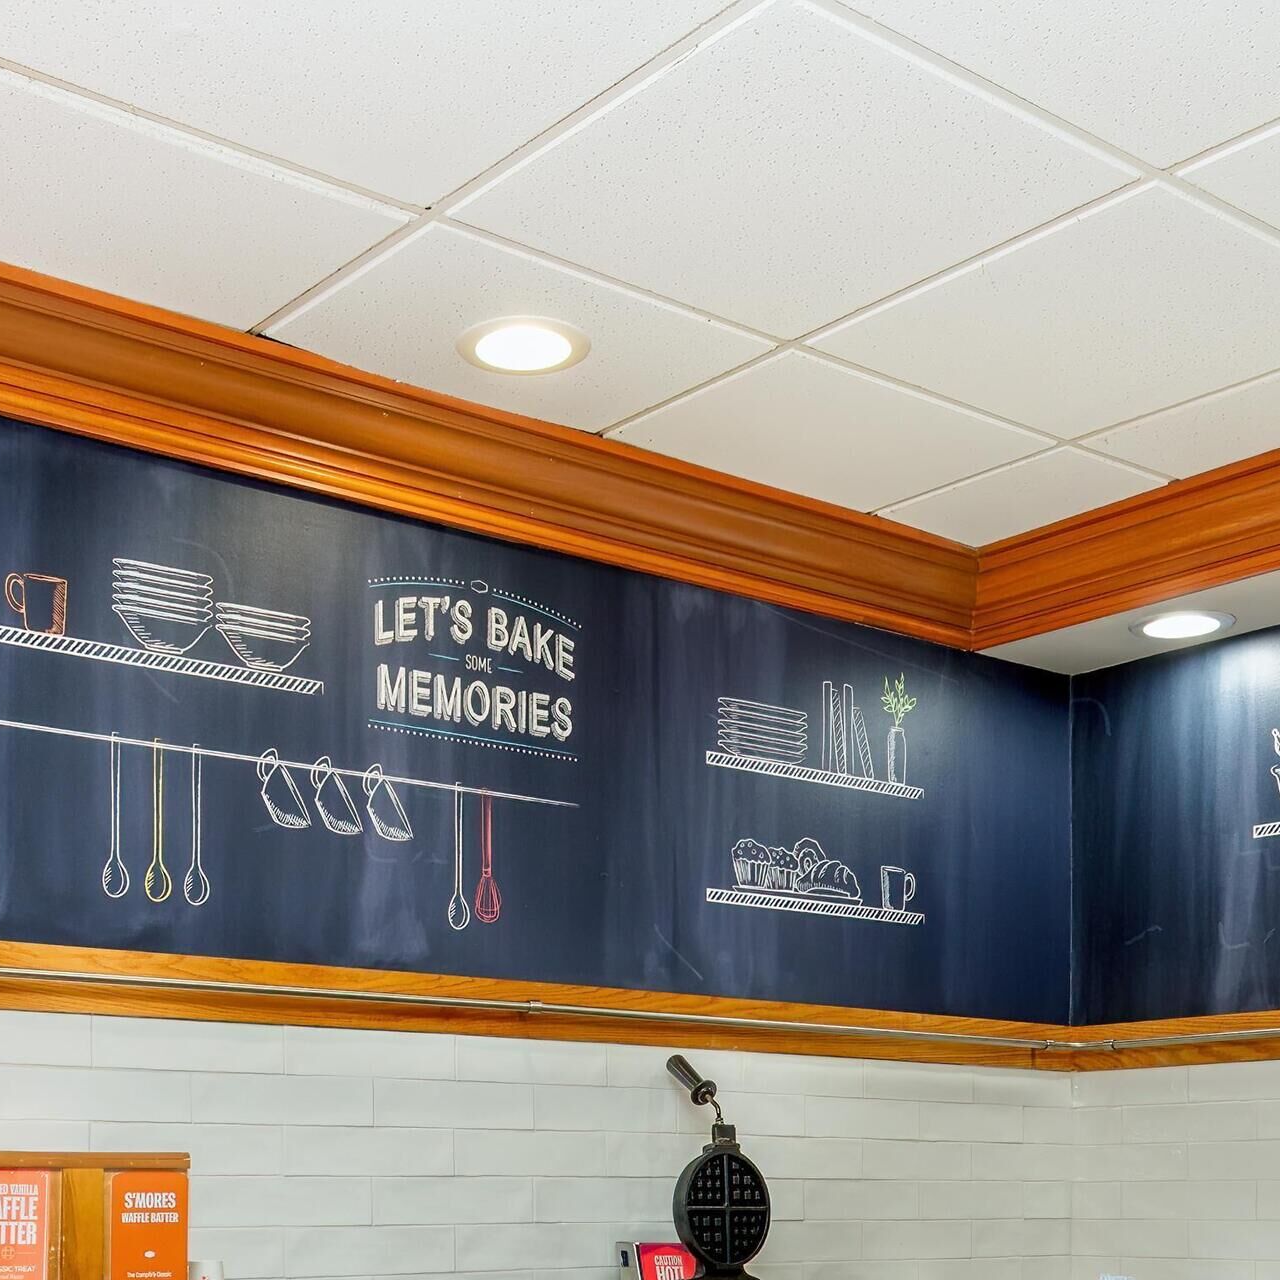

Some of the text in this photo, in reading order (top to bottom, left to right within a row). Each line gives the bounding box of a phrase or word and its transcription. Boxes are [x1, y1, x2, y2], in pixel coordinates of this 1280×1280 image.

[374, 596, 575, 682] LET'S BAKE
[465, 654, 493, 674] SOME
[377, 664, 573, 742] MEMORIES
[124, 1192, 176, 1208] S'MORES
[121, 1212, 179, 1223] WAFFLE BATTER
[654, 1255, 682, 1265] CAUTION
